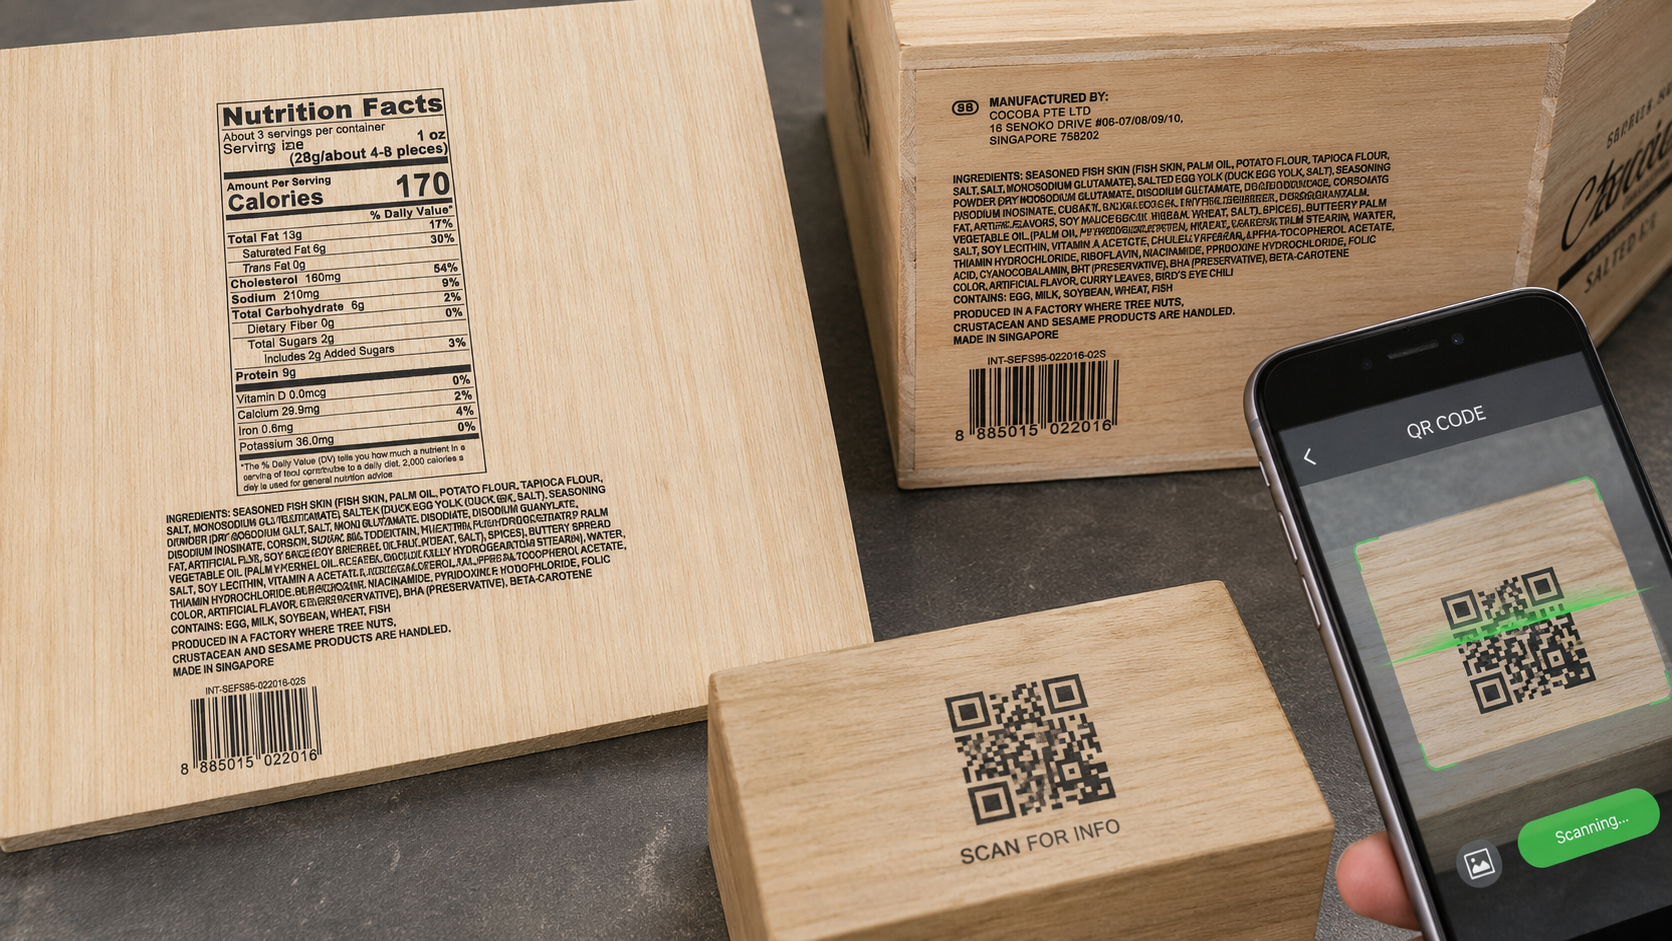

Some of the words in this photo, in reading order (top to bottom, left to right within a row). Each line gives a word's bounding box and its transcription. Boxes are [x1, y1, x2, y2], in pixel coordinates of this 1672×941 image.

[989, 92, 1086, 107] MANUFACTURED
[1089, 91, 1108, 102] BY:
[222, 101, 352, 126] Nutrition
[362, 93, 444, 117] Facts
[989, 108, 1040, 120] COCOBA
[1043, 107, 1065, 118] PTE
[1069, 105, 1091, 116] LTD
[223, 130, 254, 142] About
[257, 129, 264, 139] 3
[267, 127, 312, 138] servings
[315, 127, 333, 137] per
[335, 122, 385, 134] container
[989, 123, 1002, 133] 16
[1005, 120, 1054, 132] SENOKO
[1057, 118, 1092, 129] DRIVE
[417, 129, 423, 141] 1
[429, 127, 447, 140] oz
[989, 132, 1056, 145] SINGAPORE
[1060, 130, 1099, 141] 758202
[289, 147, 366, 165] (28g/about
[370, 145, 392, 158] 4-8
[226, 180, 268, 191] Amount
[271, 178, 289, 188] Per
[291, 175, 331, 186] Serving
[396, 170, 451, 197] 170
[228, 189, 323, 211] Calories
[369, 210, 380, 220] %
[429, 218, 453, 229] 17%
[227, 232, 257, 244] Total
[260, 231, 279, 242] Fat
[282, 230, 302, 243] 13g
[430, 233, 454, 244] 30%
[242, 245, 291, 258] Saturated
[293, 244, 311, 254] Fat
[312, 243, 326, 257] 6g
[242, 263, 271, 273] Trans
[273, 261, 291, 271] Fat
[292, 259, 305, 273] 0g
[433, 262, 458, 273] 54%
[1585, 232, 1637, 294] SALTED
[230, 274, 297, 288] Cholesterol
[305, 272, 340, 283] 160mg
[441, 277, 459, 287] 9%
[231, 293, 276, 304] Sodium
[283, 289, 319, 303] 210mg
[443, 291, 461, 302] 2%
[953, 292, 1006, 304] CONTAINS:
[1151, 283, 1173, 293] FISH
[231, 307, 261, 319] Total
[265, 302, 343, 317] Carbohydrate
[351, 300, 364, 311] 6g
[445, 307, 463, 317] 0%
[953, 307, 1010, 319] PRODUCED
[1013, 306, 1022, 316] IN
[1024, 306, 1032, 315] A
[1034, 302, 1082, 314] FACTORY
[1083, 300, 1122, 312] WHERE
[1123, 299, 1151, 310] TREE
[247, 323, 286, 334] Dietary
[290, 319, 317, 330] Fiber
[320, 317, 334, 331] 0g
[953, 319, 1024, 332] CRUSTACEAN
[1026, 318, 1049, 328] AND
[1051, 314, 1095, 326] SESAME
[1097, 311, 1156, 323] PRODUCTS
[1158, 309, 1180, 319] ARE
[1182, 306, 1235, 318] HANDLED.
[247, 337, 275, 349] Total
[278, 336, 317, 350] Sugars
[320, 333, 334, 347] 2g
[448, 336, 466, 347] 3%
[953, 334, 983, 345] MADE
[985, 333, 996, 343] IN
[998, 329, 1058, 342] SINGAPORE
[264, 351, 306, 363] Includes
[307, 350, 321, 362] 2g
[323, 346, 356, 359] Added
[359, 345, 394, 359] Sugars
[235, 368, 278, 381] Protein
[282, 367, 296, 379] 9g
[452, 374, 470, 385] 0%
[236, 391, 275, 404] Vitamin
[277, 390, 286, 400] D
[288, 388, 326, 402] 0.0mcg
[454, 390, 472, 401] 2%
[455, 405, 474, 416] 4%
[238, 425, 258, 436] Iron
[261, 423, 293, 433] 0.6mg
[457, 421, 476, 431] 0%
[955, 430, 964, 441] 8
[977, 424, 1038, 440] 885015
[1050, 419, 1112, 434] 022016
[1406, 419, 1434, 439] QR
[1436, 405, 1487, 424] CODE
[239, 438, 293, 452] Potassium
[295, 435, 334, 446] 36.0mg
[166, 508, 230, 523] INGREDIENTS:
[232, 503, 284, 517] SEASONED
[286, 500, 307, 511] FISH
[309, 498, 332, 509] SKIN
[334, 495, 359, 509] (FISH
[389, 490, 416, 501] PALM
[439, 484, 480, 496] POTATO
[519, 477, 565, 489] TAPIOCA
[170, 621, 223, 634] CONTAINS:
[368, 603, 390, 614] FISH
[171, 636, 226, 650] PRODUCED
[228, 634, 238, 644] IN
[240, 634, 248, 643] A
[249, 628, 296, 642] FACTORY
[297, 624, 335, 637] WHERE
[336, 620, 364, 632] TREE
[172, 647, 241, 664] CRUSTACEAN
[243, 645, 266, 656] AND
[267, 639, 312, 653] SESAME
[314, 632, 373, 648] PRODUCTS
[375, 629, 396, 641] ARE
[398, 624, 451, 638] HANDLED.
[172, 664, 201, 676] MADE
[203, 663, 213, 673] IN
[215, 656, 274, 672] SINGAPORE
[180, 763, 189, 775] 8
[200, 756, 254, 773] 885015
[264, 749, 317, 766] 022016
[960, 838, 1020, 864] SCAN
[1026, 830, 1069, 851] FOR
[1074, 818, 1120, 841] INFO
